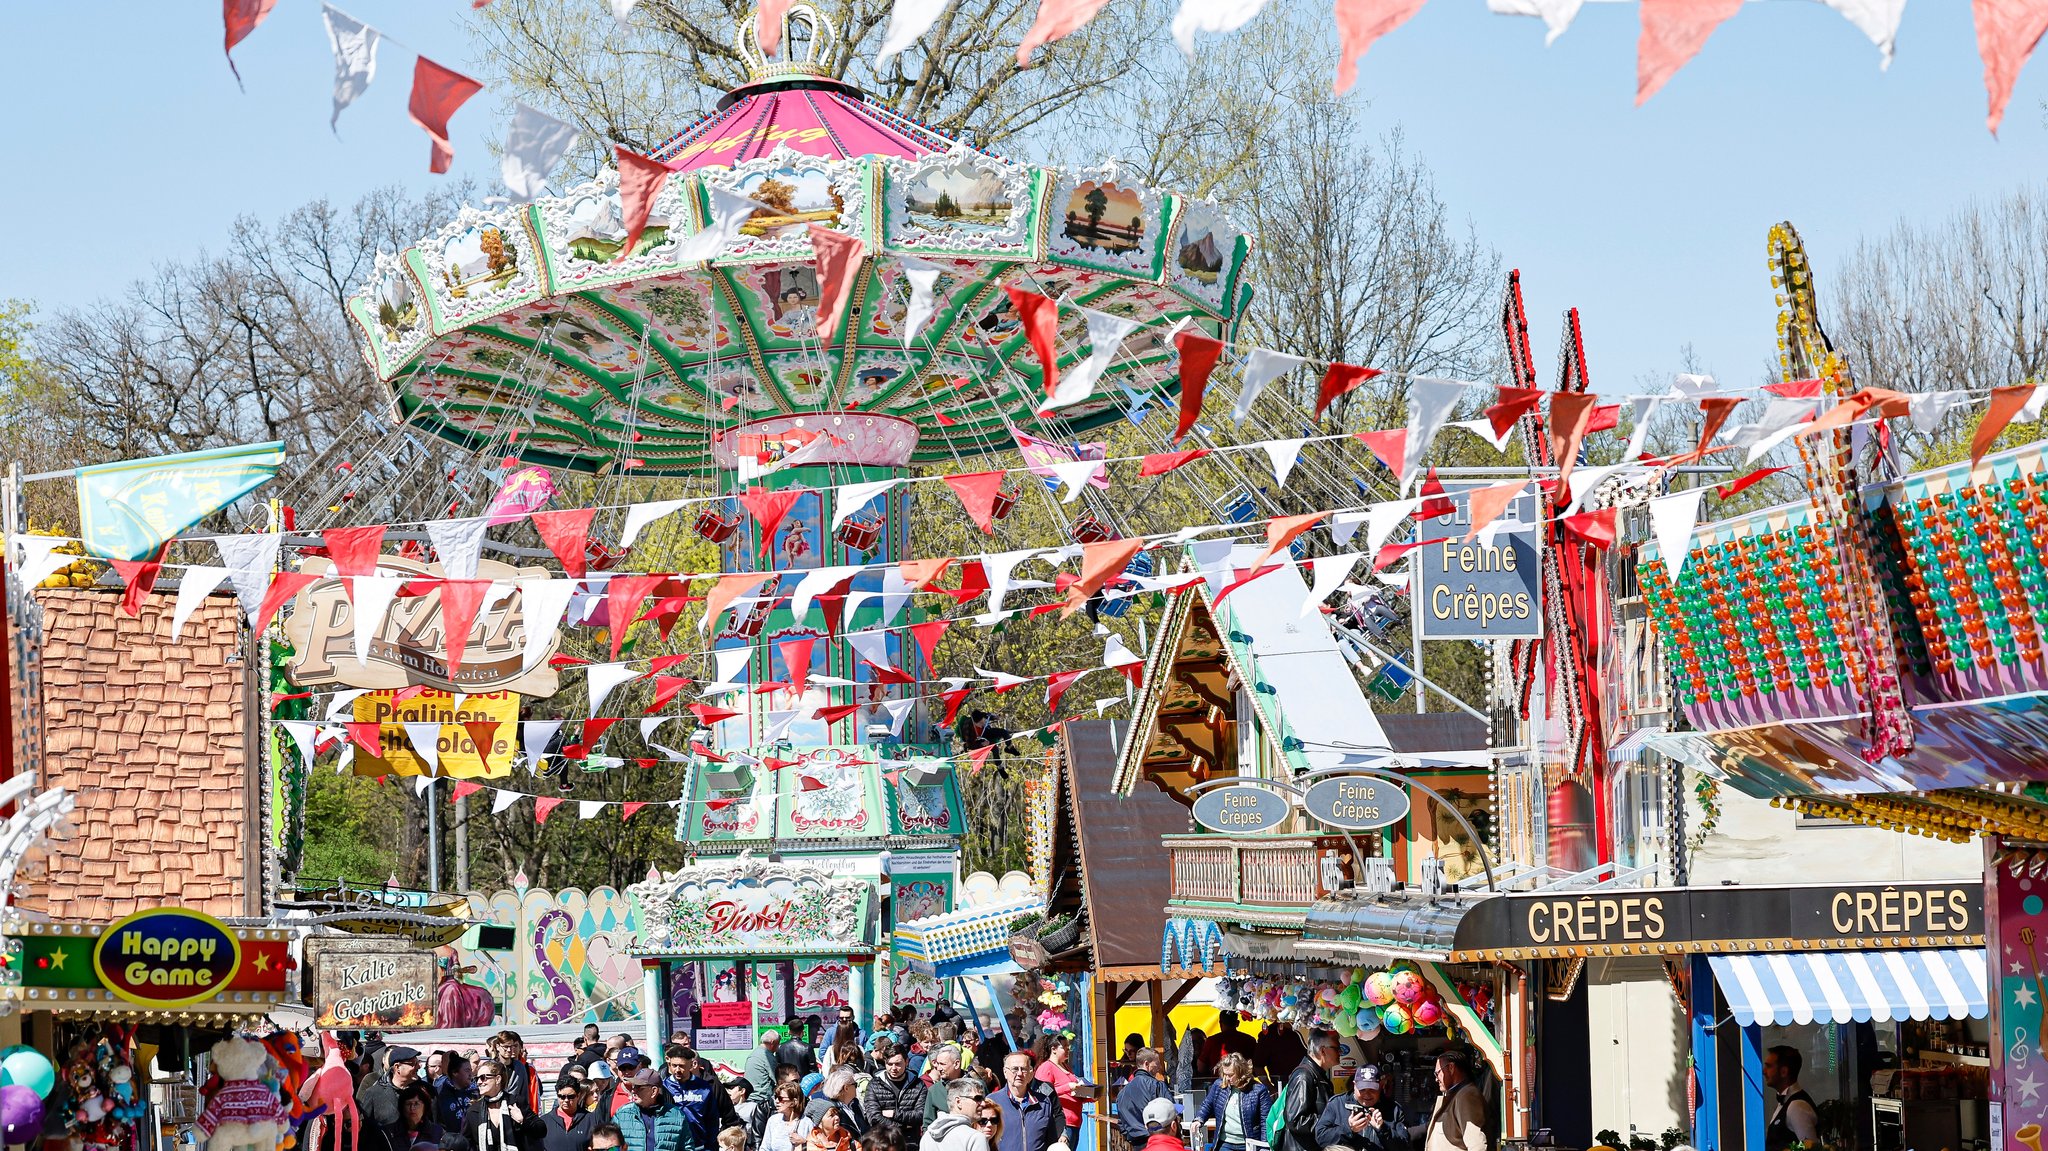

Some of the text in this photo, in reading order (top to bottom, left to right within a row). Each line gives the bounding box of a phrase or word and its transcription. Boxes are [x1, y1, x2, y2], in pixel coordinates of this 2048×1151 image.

[1442, 538, 1518, 572] Feine
[1432, 584, 1531, 629] Crêpes
[295, 586, 532, 679] PIZA
[372, 730, 509, 755] choolae
[1223, 793, 1257, 808] Feine
[1337, 782, 1375, 801] Feine
[1219, 806, 1263, 826] Crêpes
[1332, 799, 1380, 820] Crêpes
[1527, 896, 1666, 943] CRÊPES
[1832, 886, 1970, 934] CRÊPES
[121, 930, 217, 964] Happy
[125, 962, 214, 987] Game
[340, 960, 396, 990] Kalte
[334, 983, 426, 1021] Getränke
